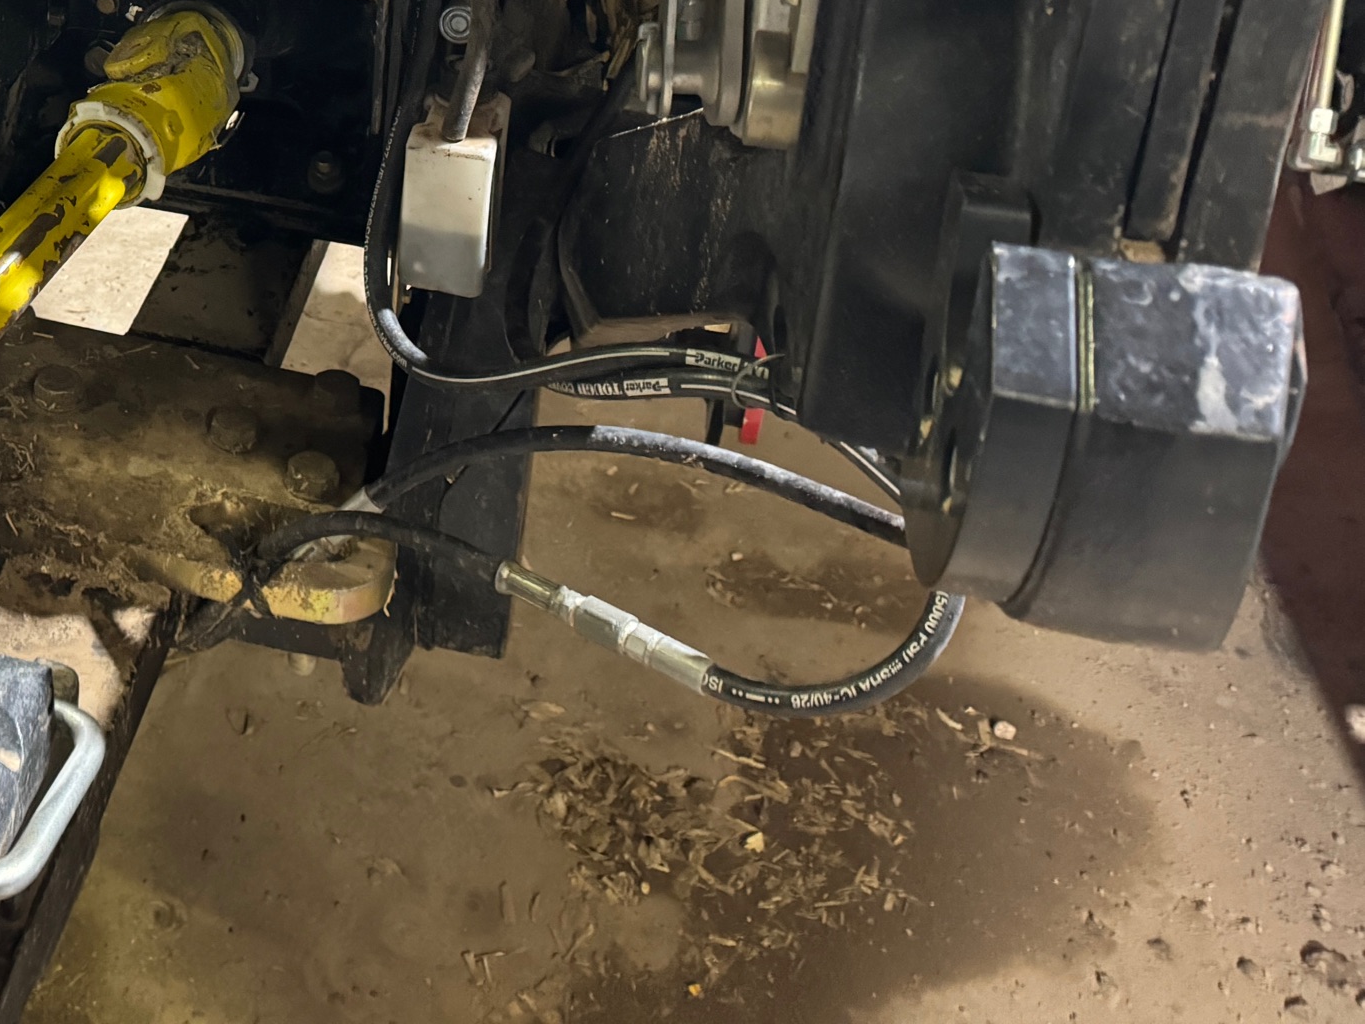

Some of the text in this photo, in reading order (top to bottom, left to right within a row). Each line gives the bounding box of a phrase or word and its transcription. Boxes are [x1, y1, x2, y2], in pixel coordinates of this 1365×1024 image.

[695, 351, 738, 372] Parker
[577, 382, 623, 396] TOUGH
[625, 379, 663, 393] Parker
[924, 590, 950, 635] (5000
